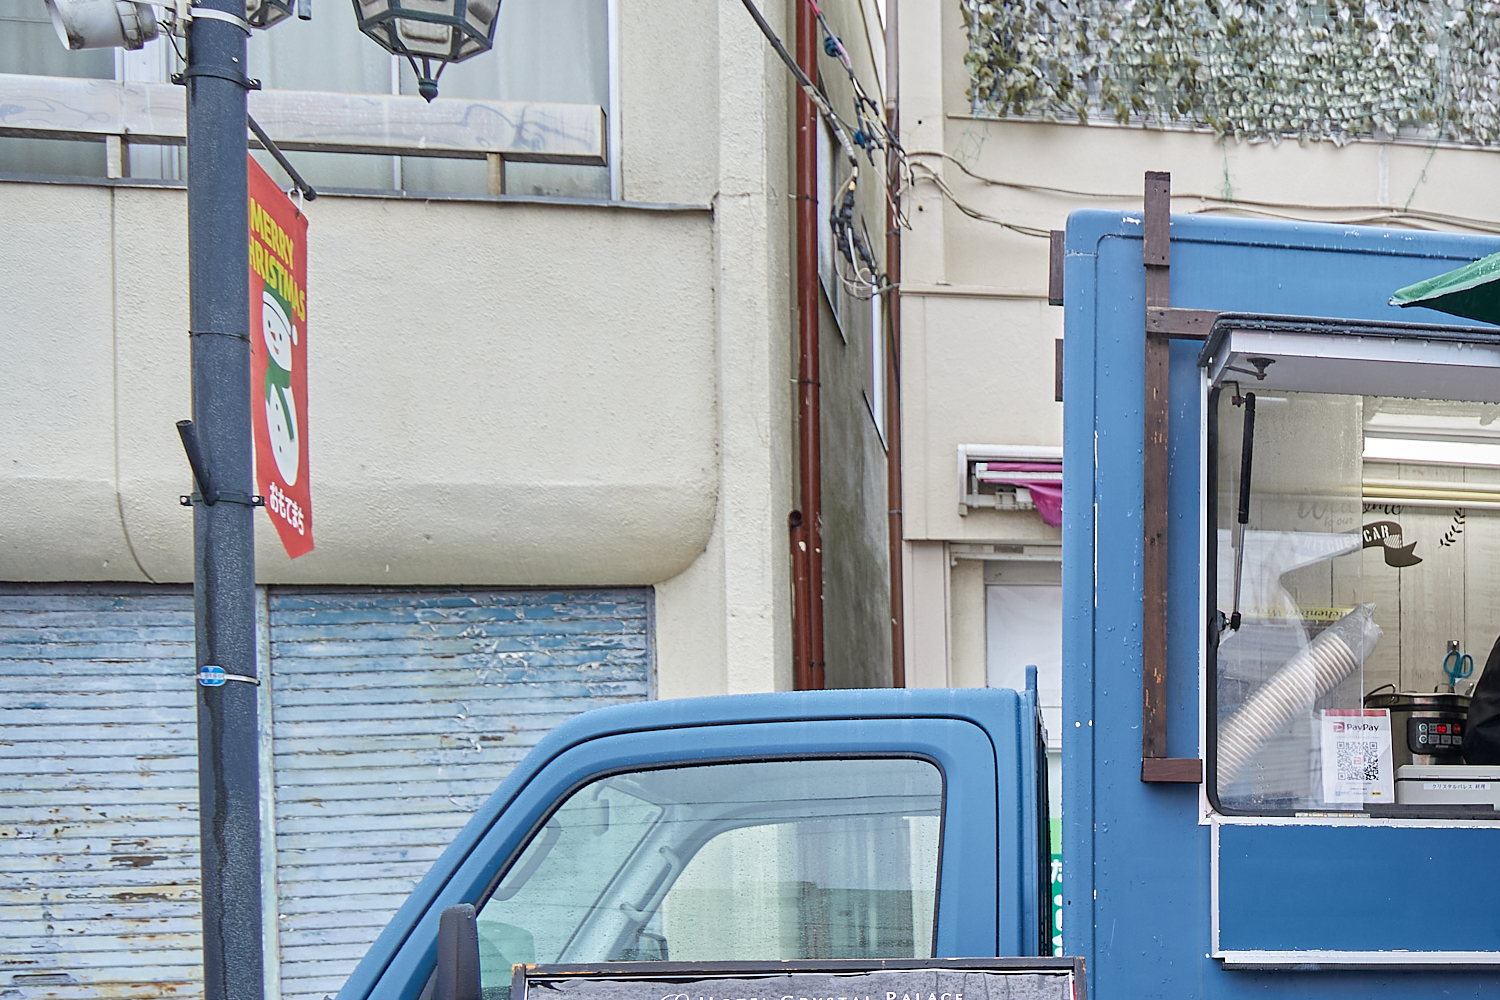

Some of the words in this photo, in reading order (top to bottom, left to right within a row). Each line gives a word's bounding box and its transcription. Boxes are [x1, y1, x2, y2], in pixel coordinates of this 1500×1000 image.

[250, 197, 294, 270] MERRY
[249, 236, 305, 322] HRISTMAS
[269, 482, 305, 535] おもてまち
[1363, 525, 1390, 543] CAR
[1346, 723, 1380, 732] PayPay
